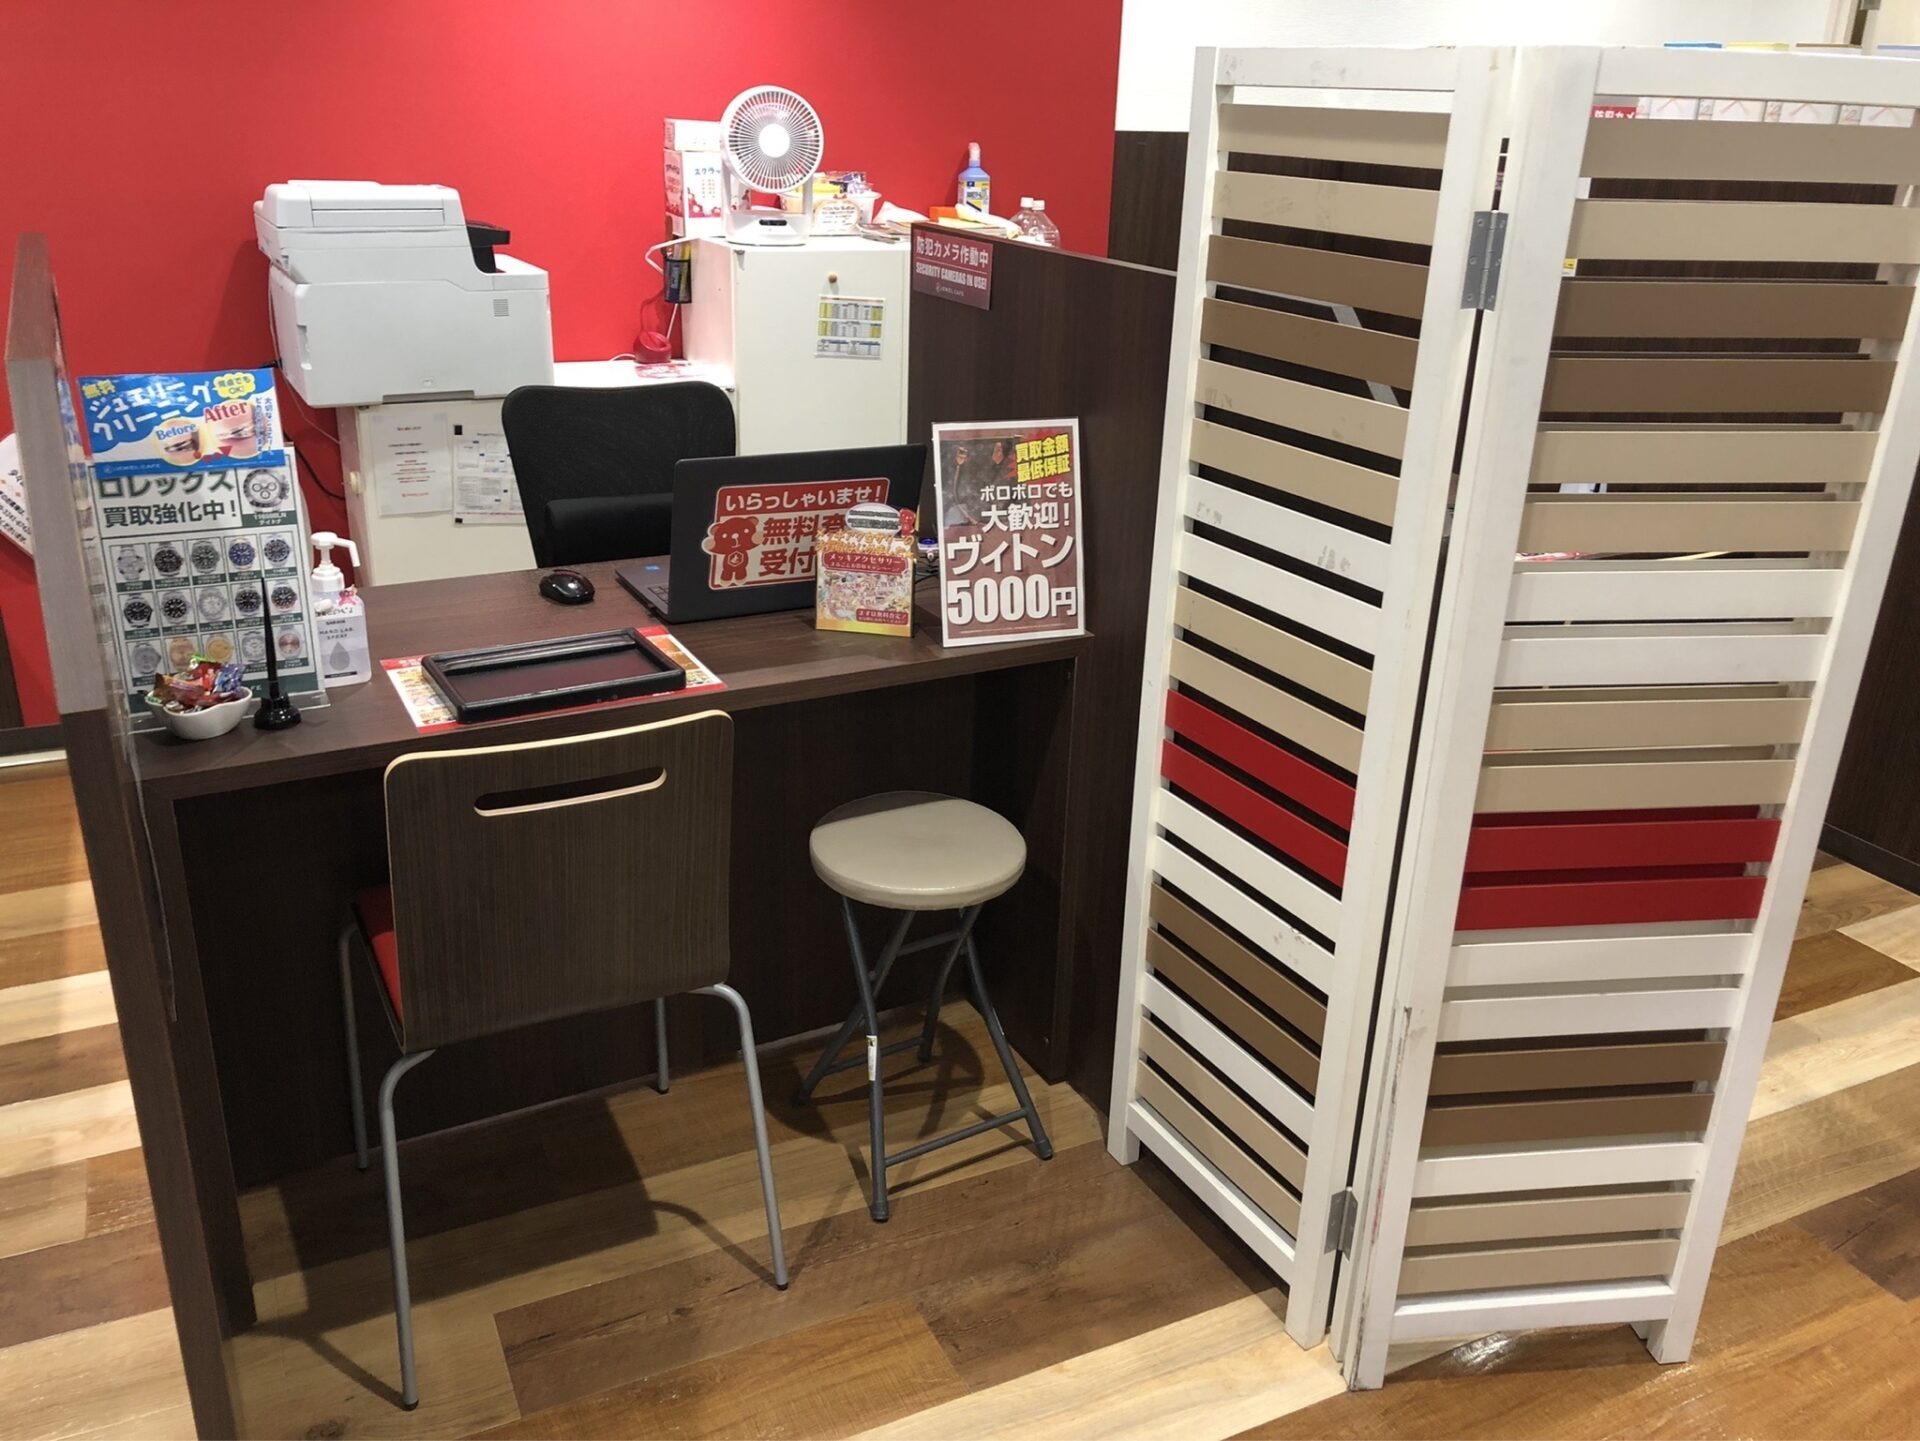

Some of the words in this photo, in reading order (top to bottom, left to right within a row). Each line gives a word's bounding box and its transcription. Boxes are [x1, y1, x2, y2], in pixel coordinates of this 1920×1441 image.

[916, 236, 989, 268] 防犯カメラ作動中
[915, 262, 941, 278] SECURITY
[941, 268, 966, 285] CAMERAS
[90, 381, 186, 420] ジュエリー
[92, 381, 212, 442] クリーニング
[203, 402, 248, 424] After
[155, 422, 198, 441] Before
[1015, 434, 1070, 463] 買取金額
[1017, 453, 1071, 483] 最低保証
[100, 471, 235, 499] ロレックス
[725, 485, 881, 511] いらっしゃいませ!
[980, 481, 1073, 502] ボロボロでも
[103, 499, 237, 528] 買取強化中!
[981, 502, 1071, 533] 大歓迎!
[947, 533, 1075, 575] ヴィトン
[947, 574, 1077, 625] 5000円
